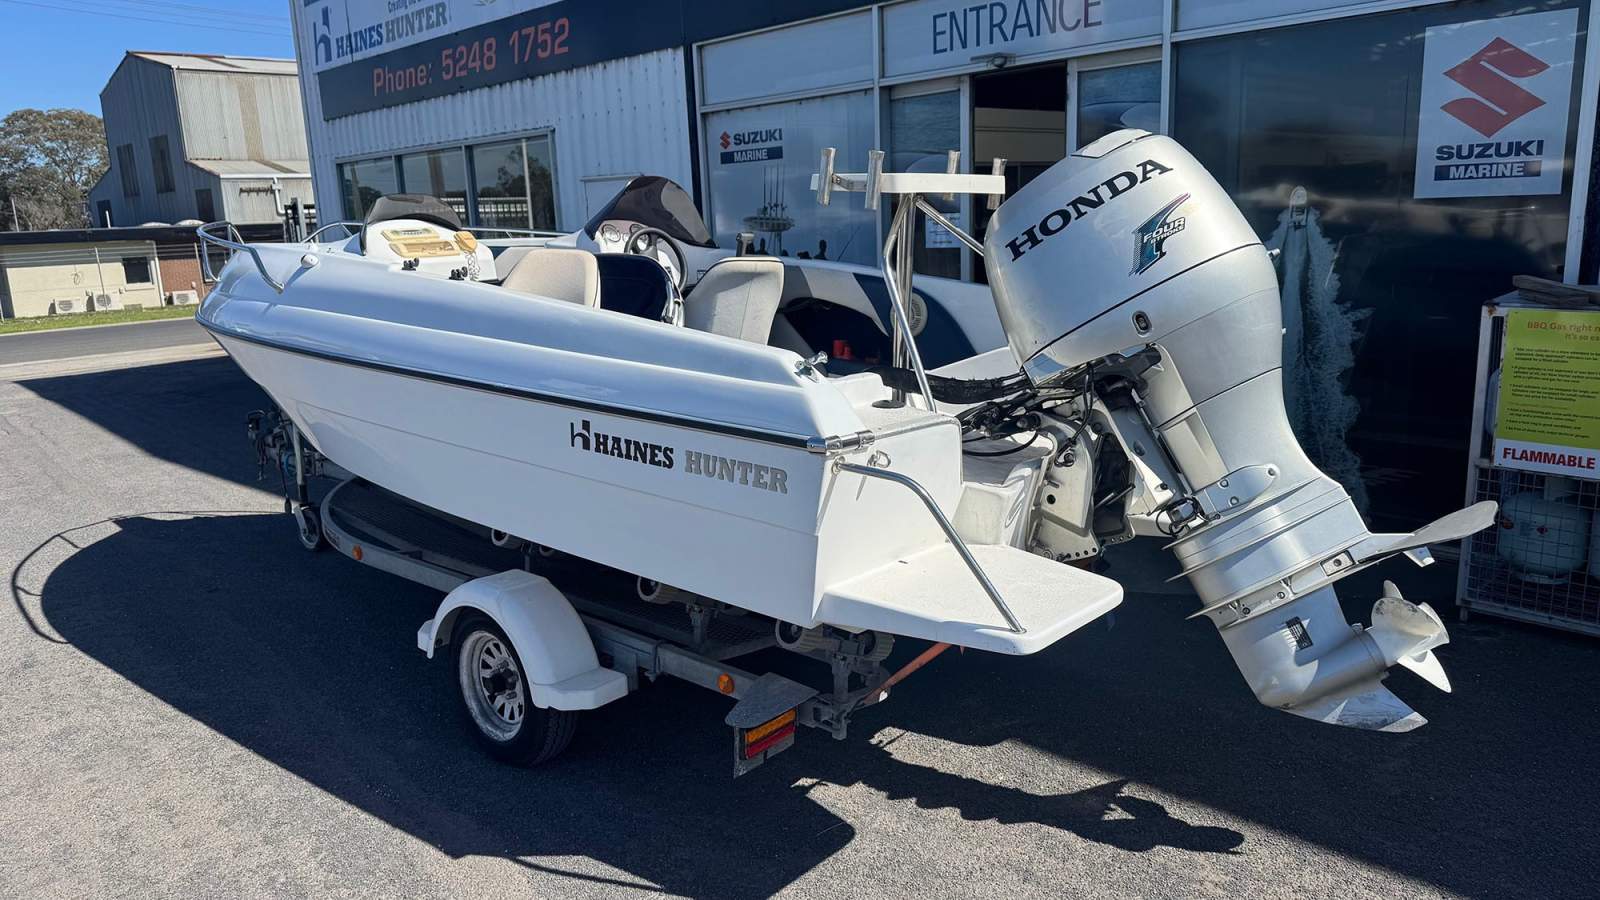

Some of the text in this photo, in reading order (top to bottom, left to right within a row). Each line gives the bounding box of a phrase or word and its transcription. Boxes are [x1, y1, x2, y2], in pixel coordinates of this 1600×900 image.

[336, 2, 447, 58] HAINES HUNTER
[933, 0, 1102, 54] ENTRANCE
[373, 17, 569, 96] Phone: 5248 1752
[733, 128, 782, 146] SUZUKI
[734, 149, 768, 162] MARINE
[1436, 140, 1544, 160] SUZUKI
[1450, 163, 1524, 179] MARINE
[1005, 159, 1173, 262] HONDA
[1143, 218, 1185, 243] FOUR
[594, 432, 788, 494] HAINES HUNTER
[1503, 447, 1596, 469] FLAMMABLE
